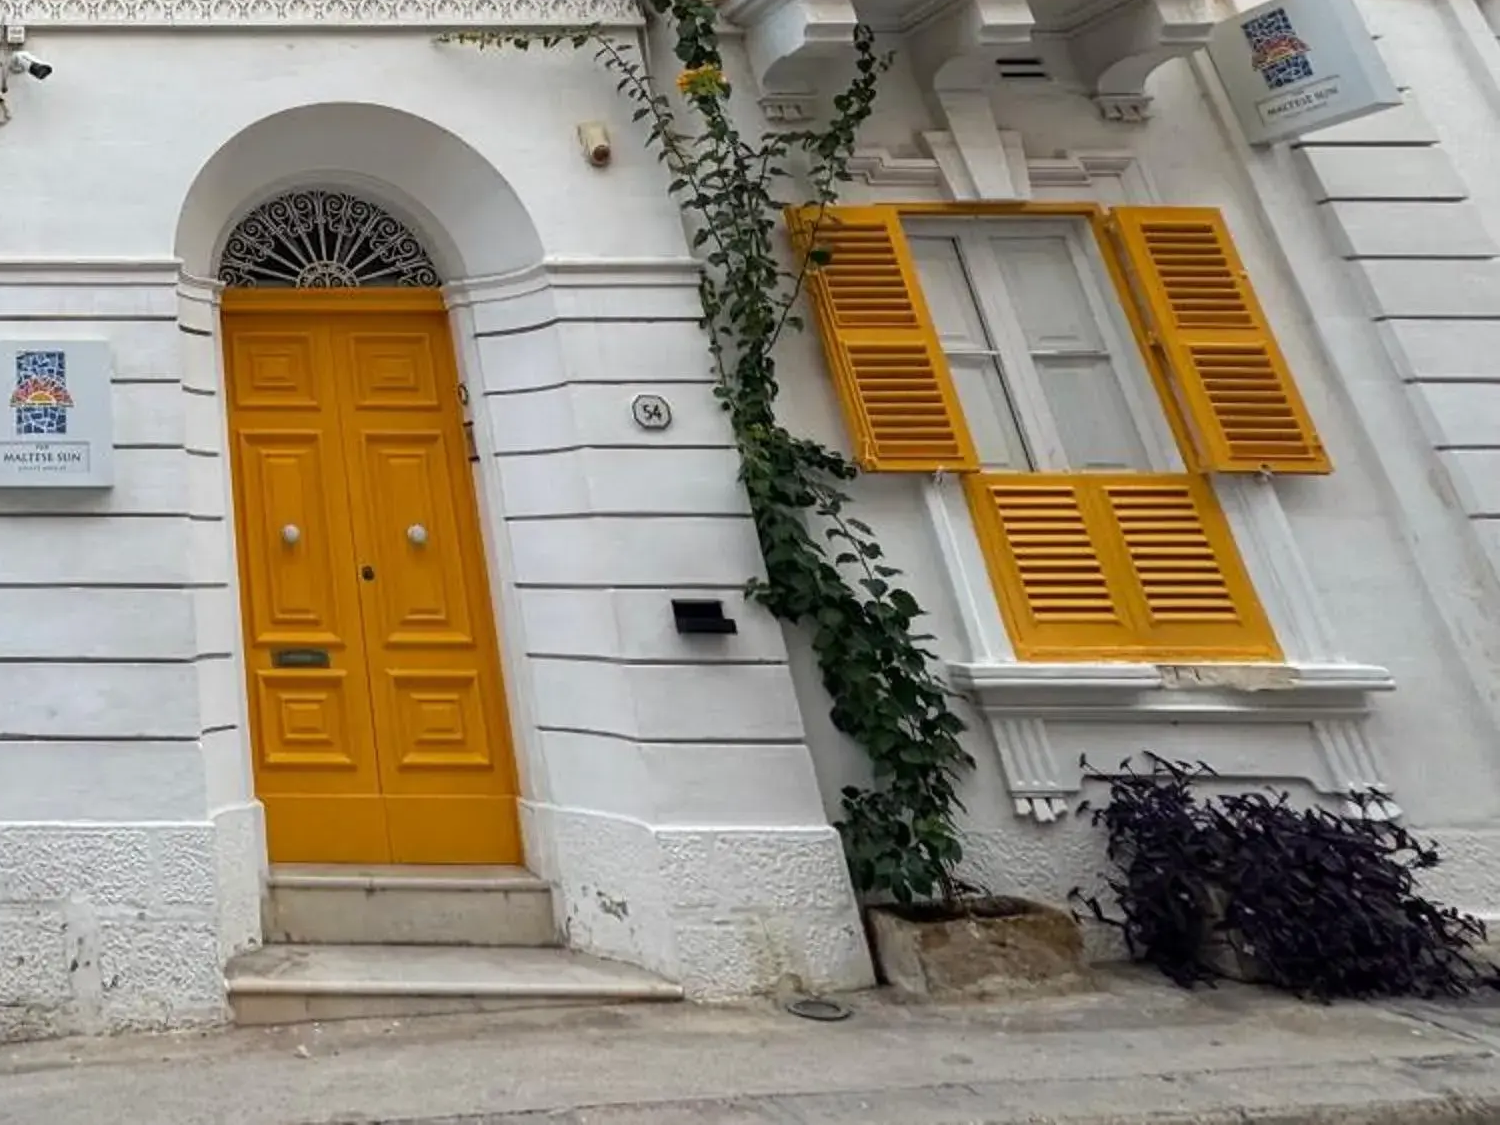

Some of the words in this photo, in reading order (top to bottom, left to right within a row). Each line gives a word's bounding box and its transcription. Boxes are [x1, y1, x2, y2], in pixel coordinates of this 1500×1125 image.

[643, 404, 662, 420] 54
[3, 452, 53, 462] MALTESE
[57, 452, 81, 462] SUN
